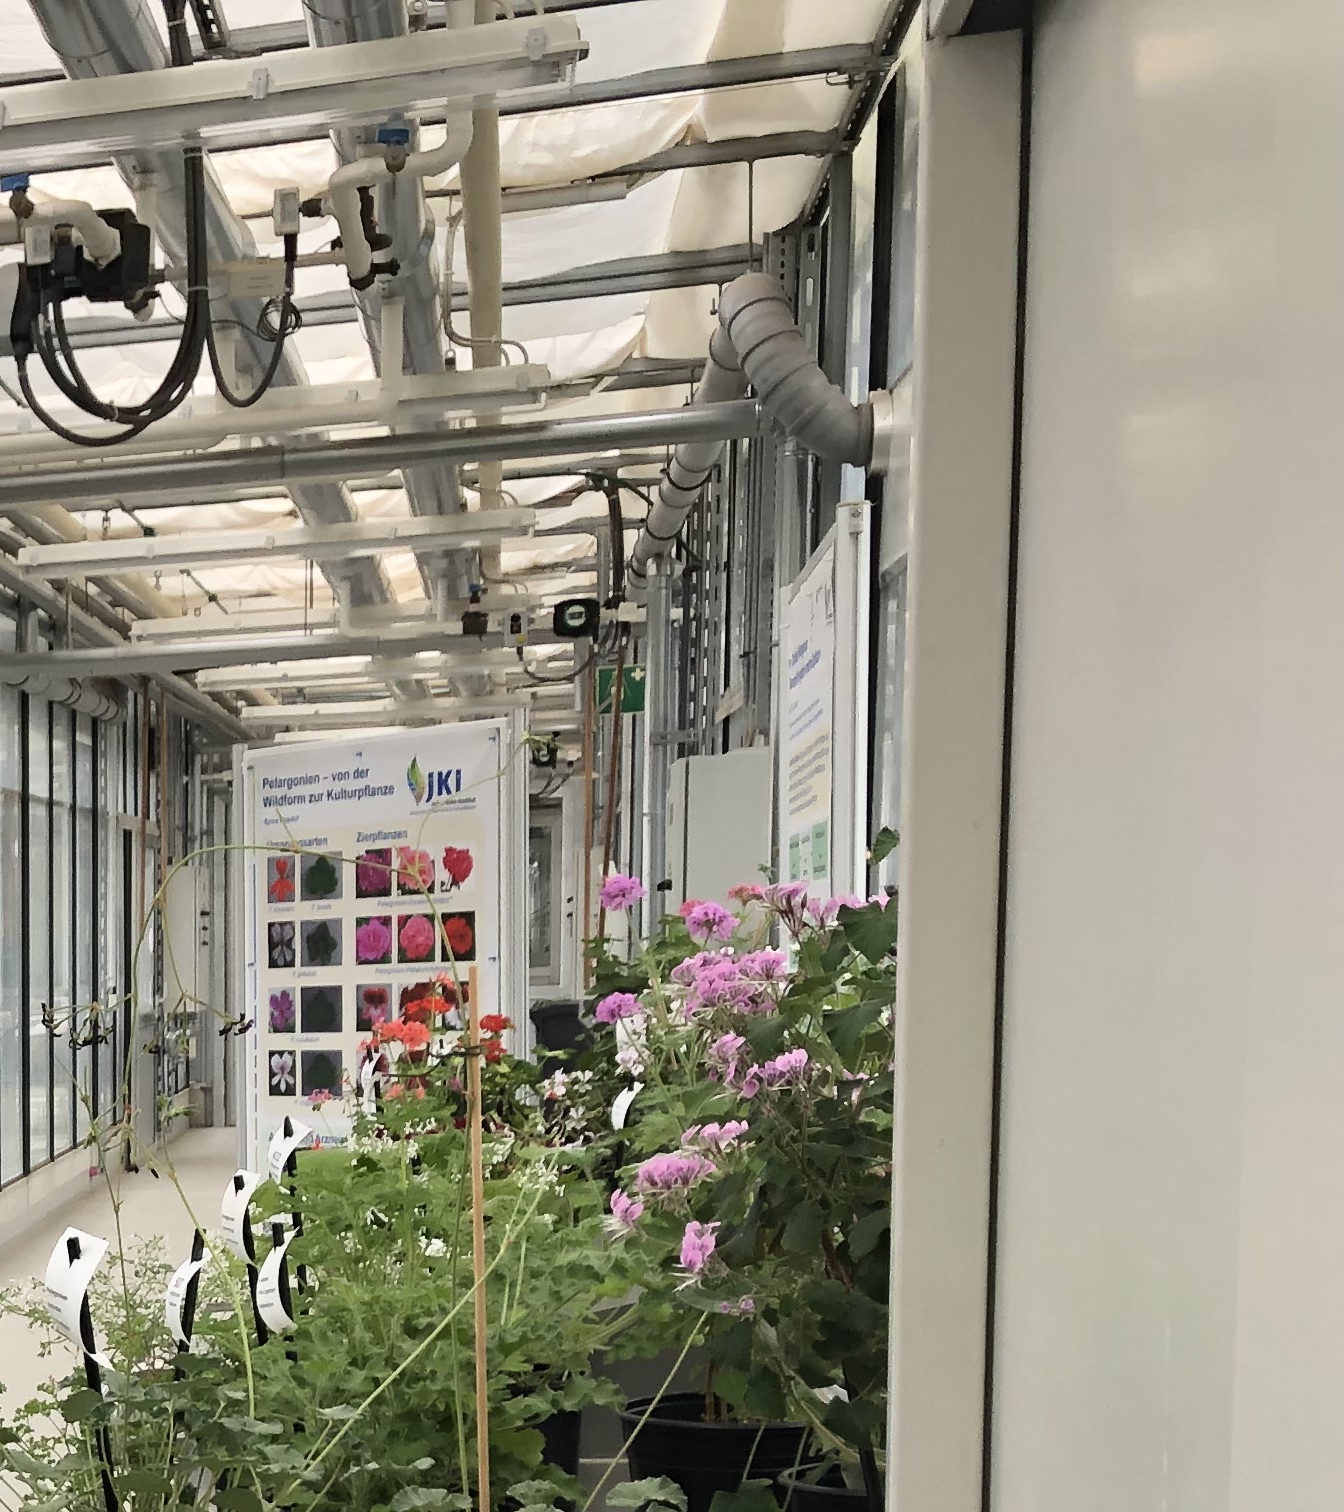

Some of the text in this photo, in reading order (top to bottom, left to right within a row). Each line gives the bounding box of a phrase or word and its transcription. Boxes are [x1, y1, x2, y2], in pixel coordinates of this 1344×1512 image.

[262, 773, 320, 790] Pelargonien
[331, 772, 350, 782] von
[353, 767, 370, 780] der
[425, 769, 462, 803] JKI
[262, 783, 395, 808] Wildform zur Kulturpflanze
[356, 829, 408, 845] Zierpflanzen
